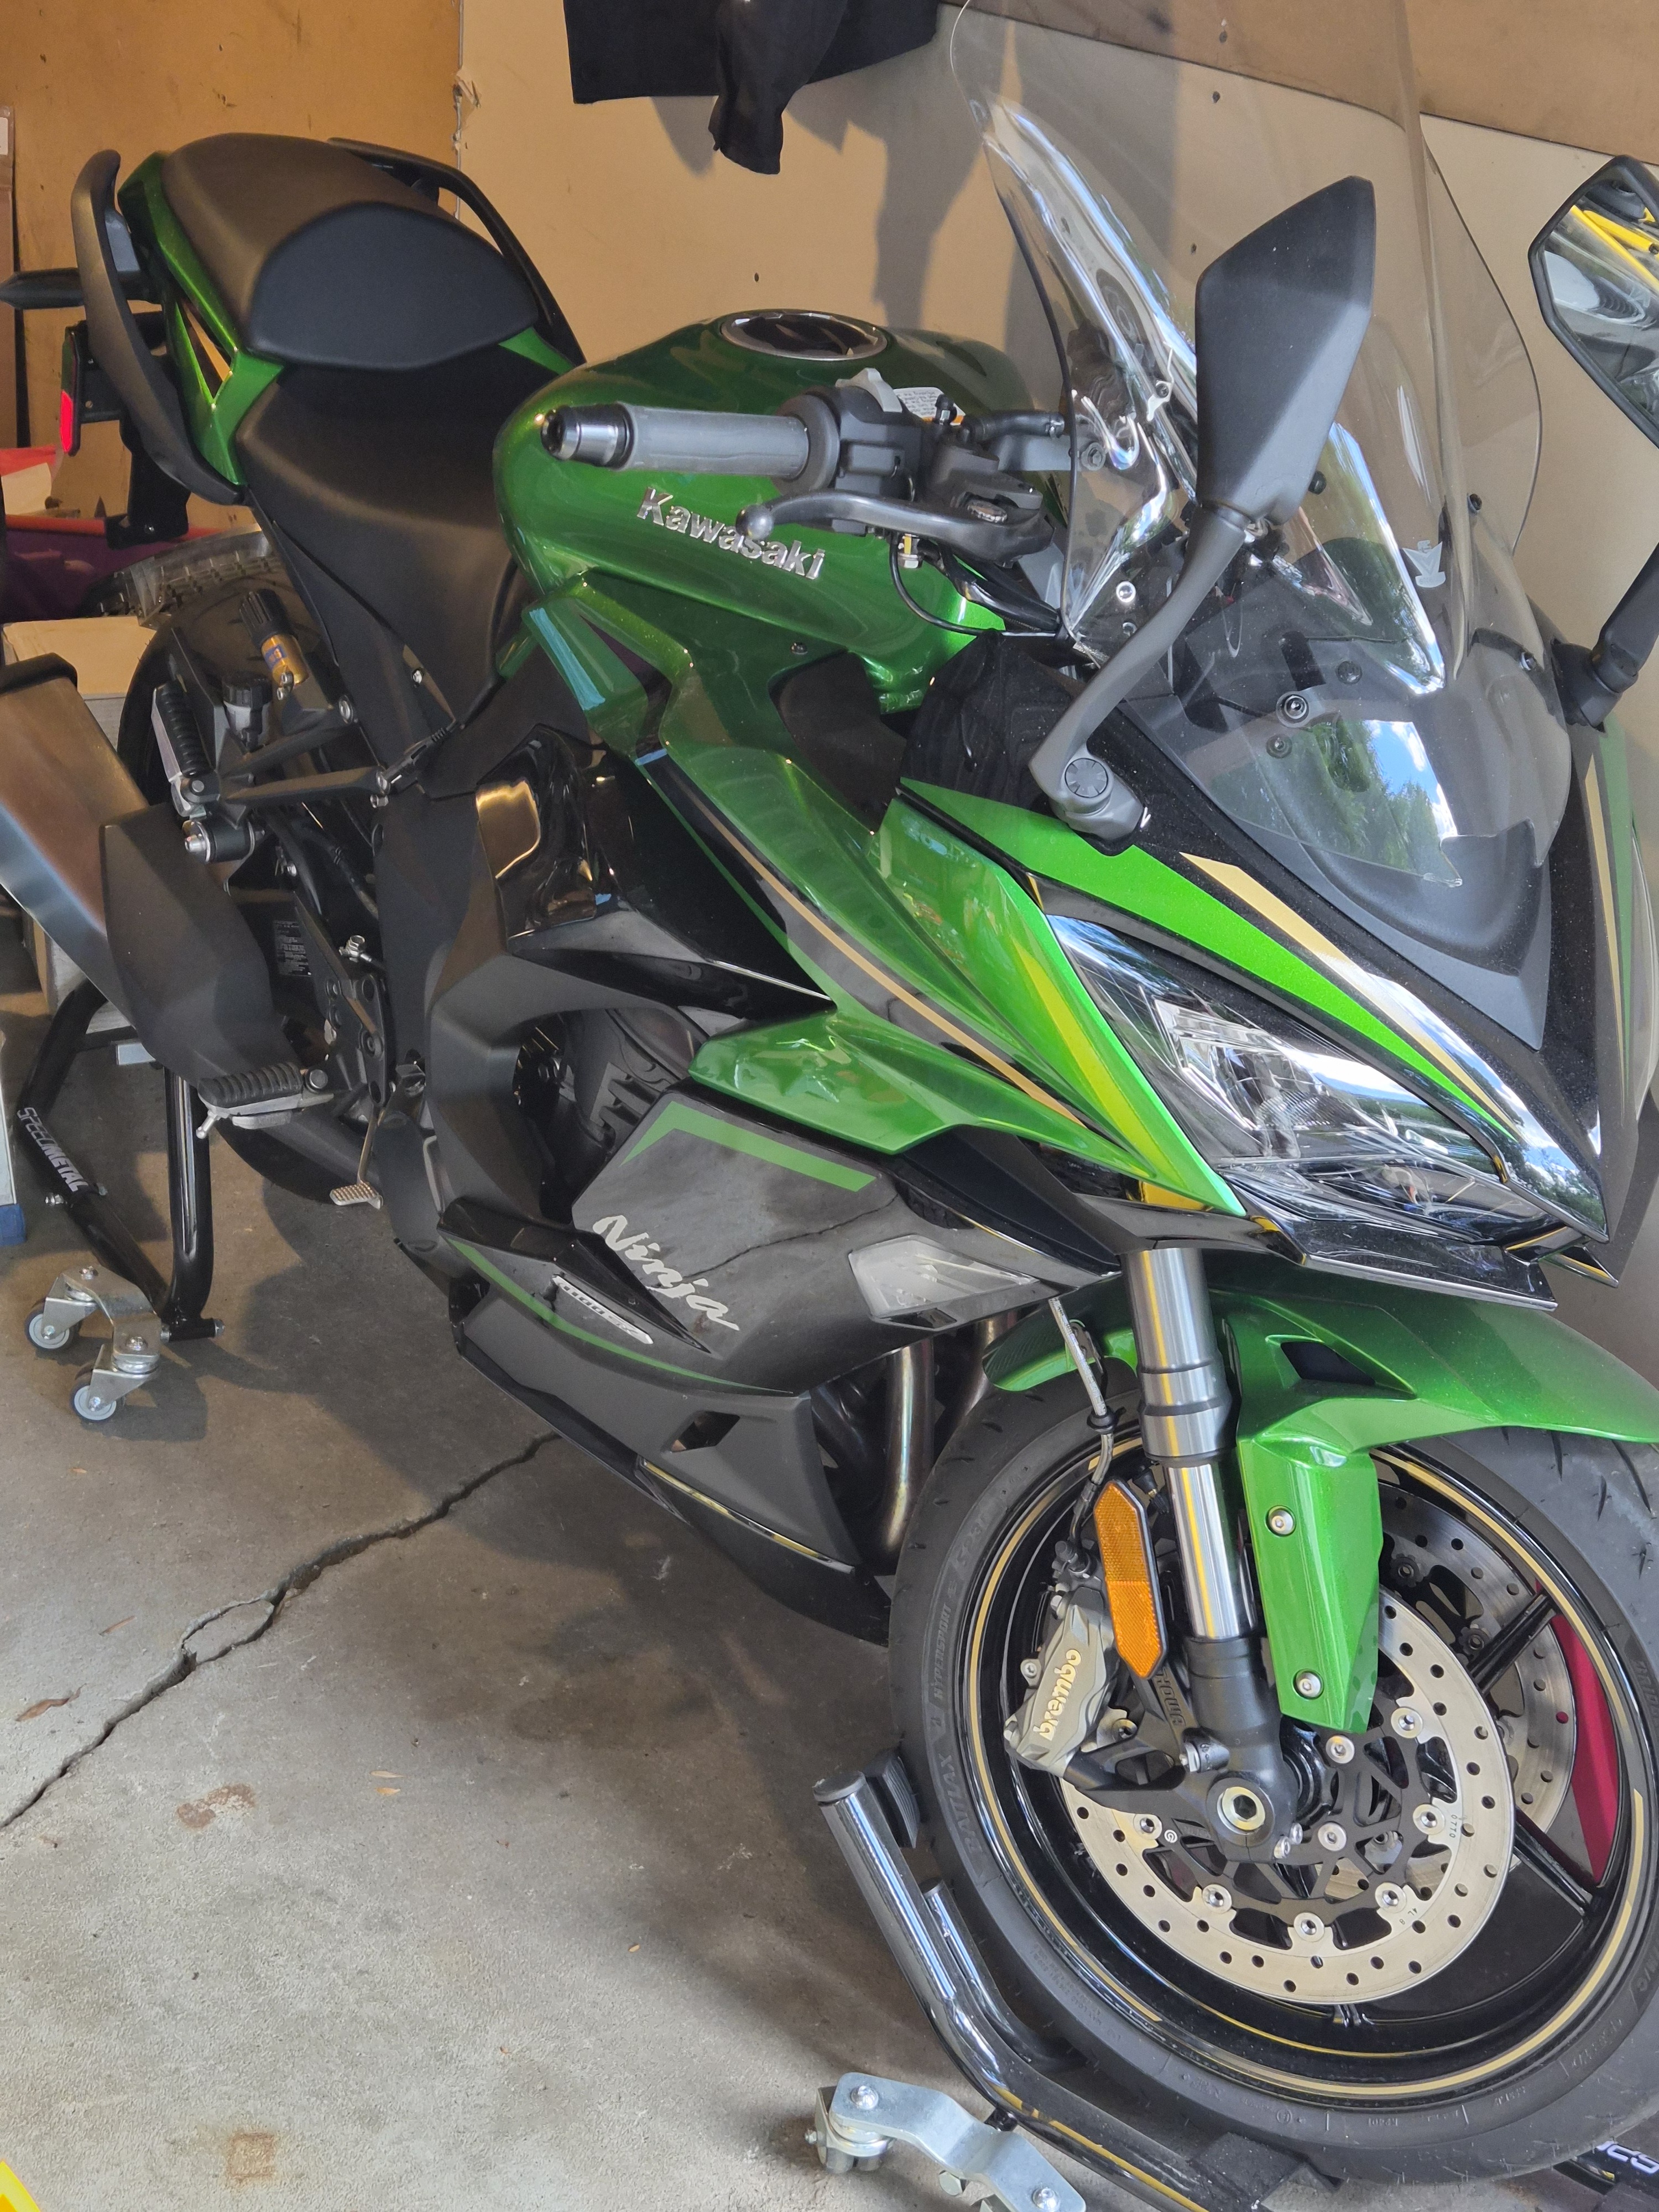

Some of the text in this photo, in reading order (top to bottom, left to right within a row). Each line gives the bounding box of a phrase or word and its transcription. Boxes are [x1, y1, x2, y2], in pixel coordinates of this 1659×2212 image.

[637, 486, 826, 580] Kawasaki
[592, 1214, 740, 1331] Ninja
[933, 1603, 952, 1700] HYPERSPORT
[1033, 1649, 1082, 1741] brembo
[1155, 1667, 1186, 1726] HOWA
[938, 1752, 984, 1853] BATTLAX
